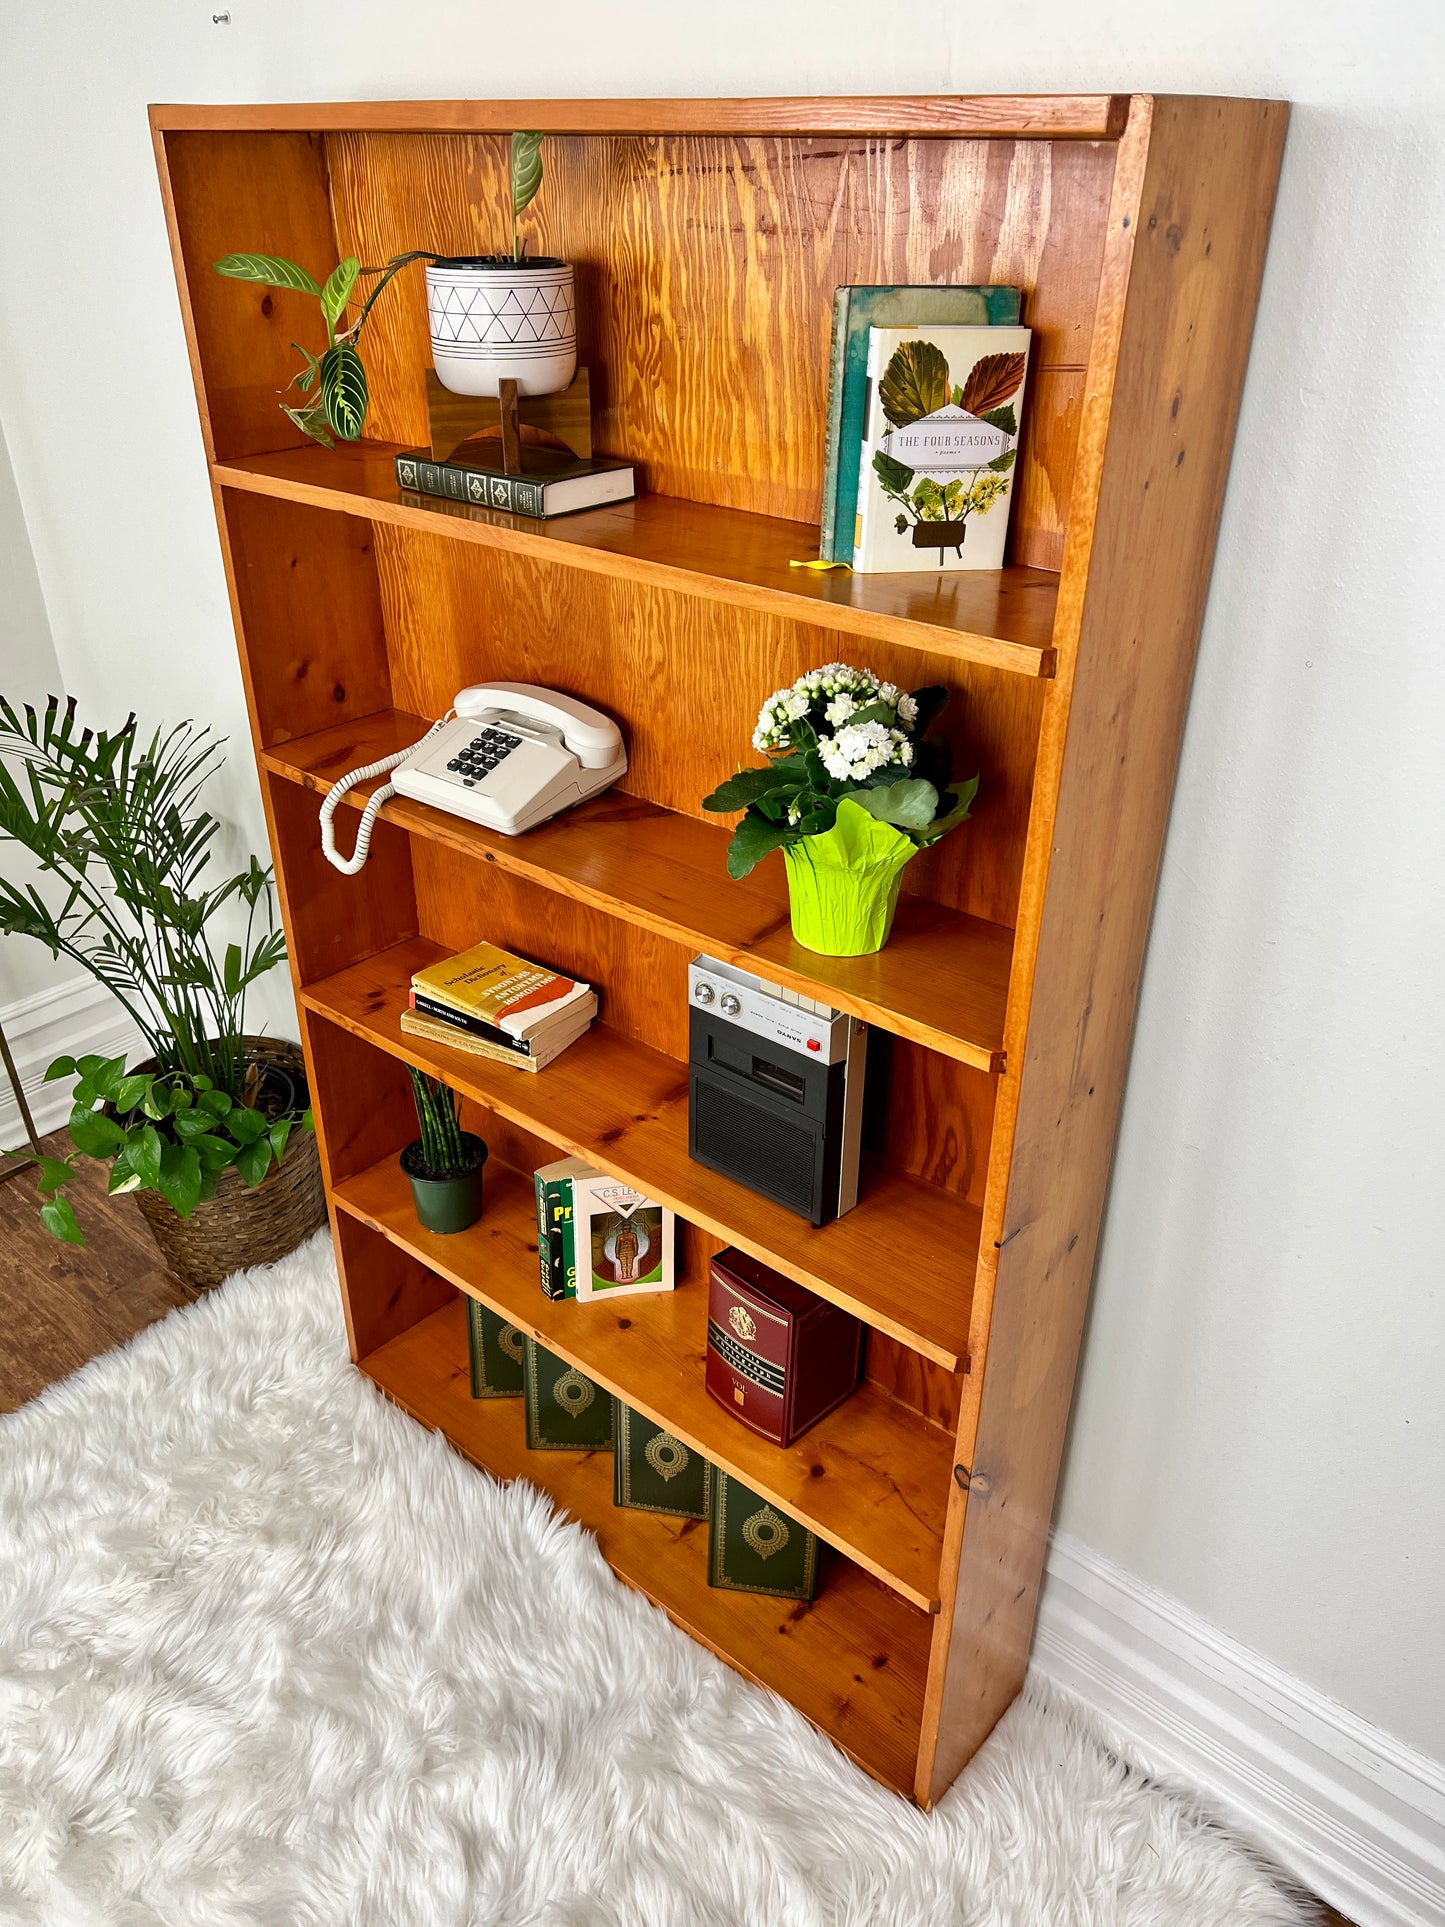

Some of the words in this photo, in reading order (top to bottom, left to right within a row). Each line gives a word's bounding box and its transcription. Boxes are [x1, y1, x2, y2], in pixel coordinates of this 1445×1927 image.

[899, 436, 919, 447] THE
[923, 436, 951, 447] FOUR
[954, 435, 1000, 447] SEASONS
[444, 966, 486, 986] Scholastic
[464, 963, 506, 985] Dictionary
[481, 970, 531, 997] SYNONYMS
[494, 972, 544, 1001] ANTONYMS
[502, 975, 556, 1006] HOMONYMS
[776, 1029, 802, 1043] SANYO
[715, 1334, 771, 1378] Photograph
[724, 1335, 760, 1364] Classic
[722, 1351, 761, 1383] Library
[731, 1377, 748, 1394] VOL
